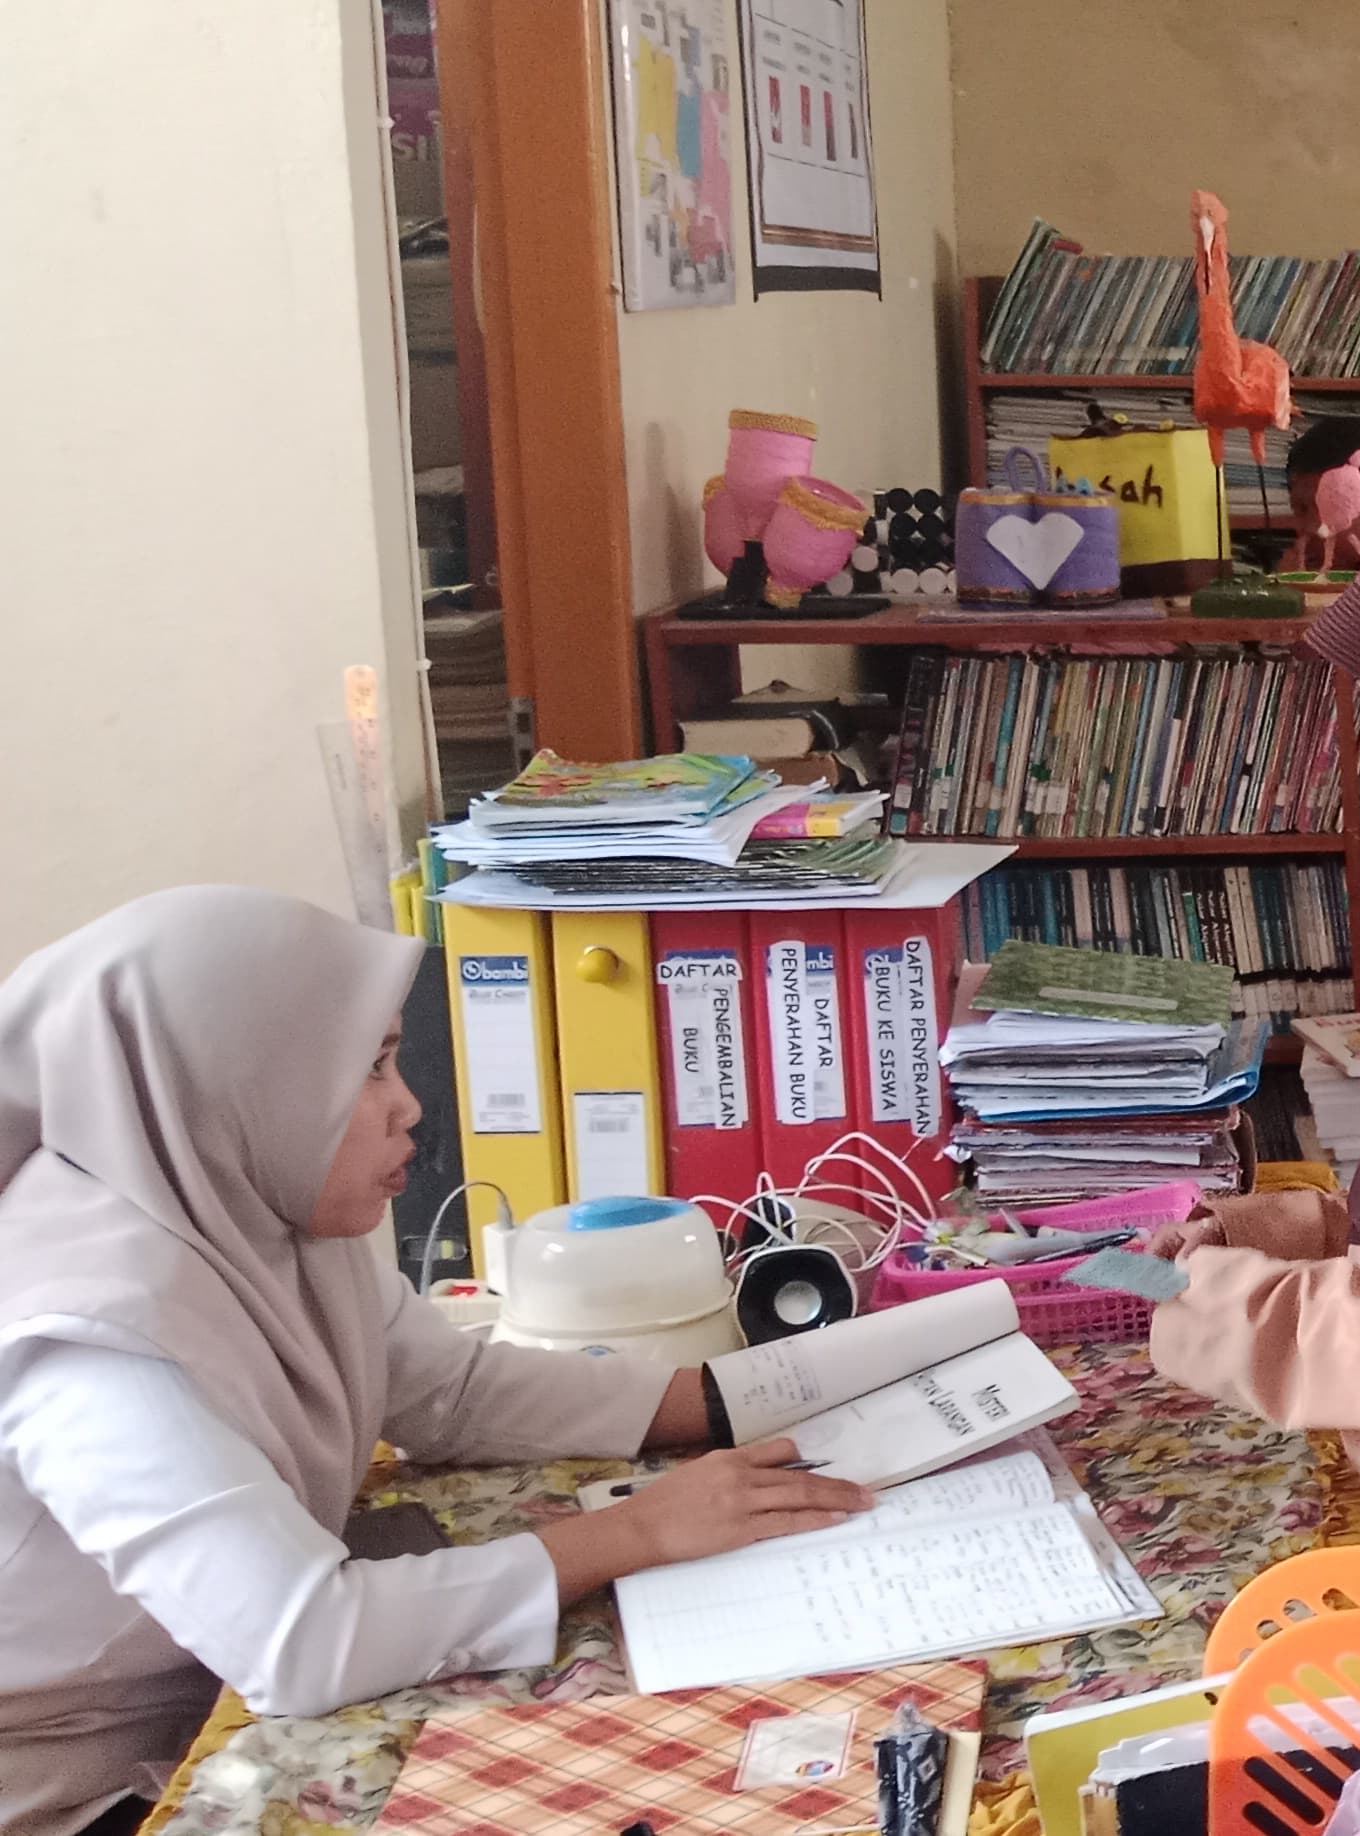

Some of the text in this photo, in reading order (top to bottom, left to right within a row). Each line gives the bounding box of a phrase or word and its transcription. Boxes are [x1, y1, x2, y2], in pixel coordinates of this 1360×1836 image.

[660, 963, 737, 979] DAFTAR
[781, 948, 807, 1119] PENYERAHAN BUKU
[814, 998, 834, 1068] DAFTAR
[874, 967, 897, 1111] BUKU KE SISWA
[905, 940, 931, 1134] DAFTAR PENYERAHAN
[683, 1027, 699, 1073] BUKU
[713, 988, 735, 1127] PENGEMBALIAN
